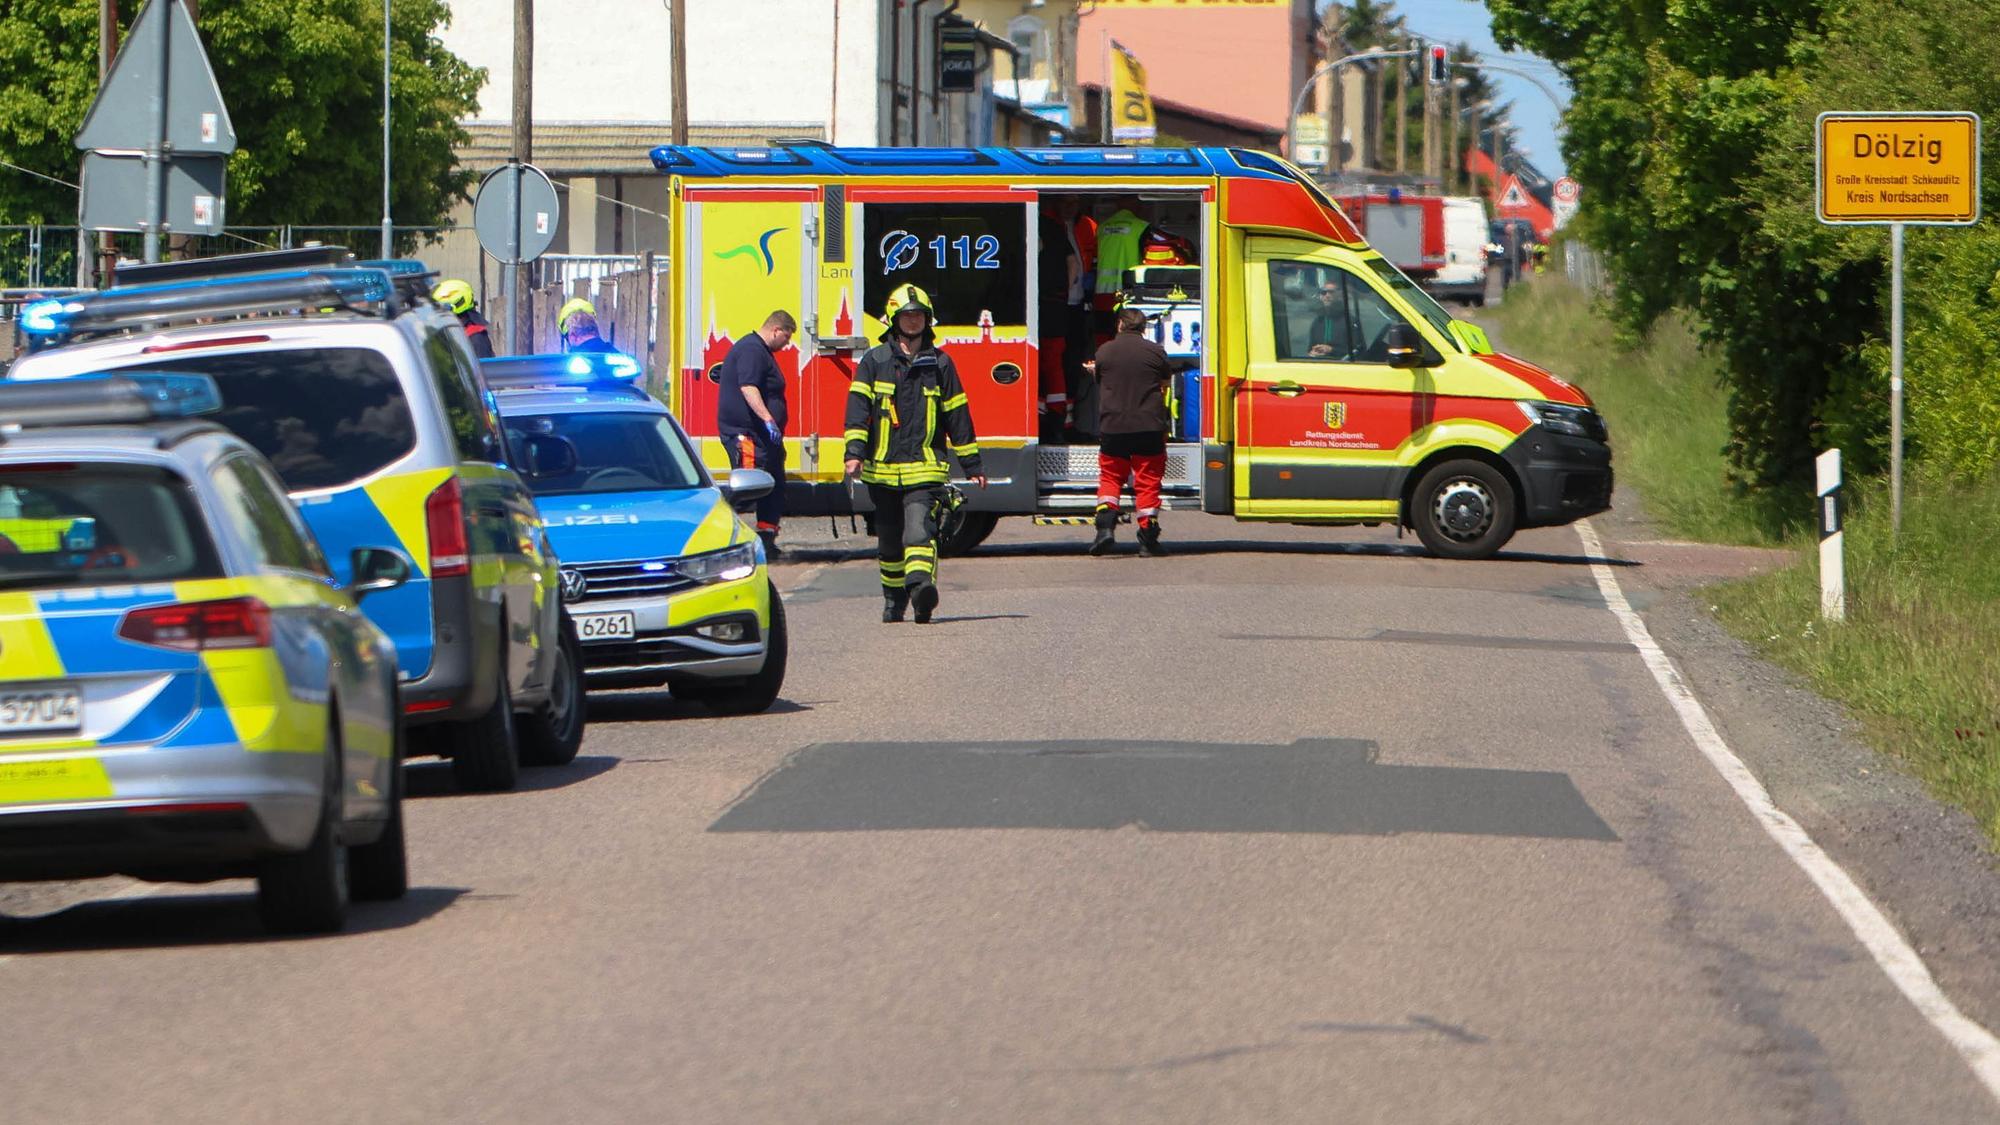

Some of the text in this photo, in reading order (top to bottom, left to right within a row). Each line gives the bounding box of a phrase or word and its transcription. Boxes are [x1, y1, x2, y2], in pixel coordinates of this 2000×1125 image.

[1853, 133, 1942, 164] Dölzig
[1836, 174, 1960, 185] Große Kreisstadt Schkeuditz
[1846, 190, 1949, 204] Kreis Nordsachsen
[929, 235, 1000, 269] 112
[1305, 430, 1365, 440] Rettungsdienst
[1289, 439, 1379, 449] Landkreis Nordsachsen
[583, 615, 631, 637] 6261
